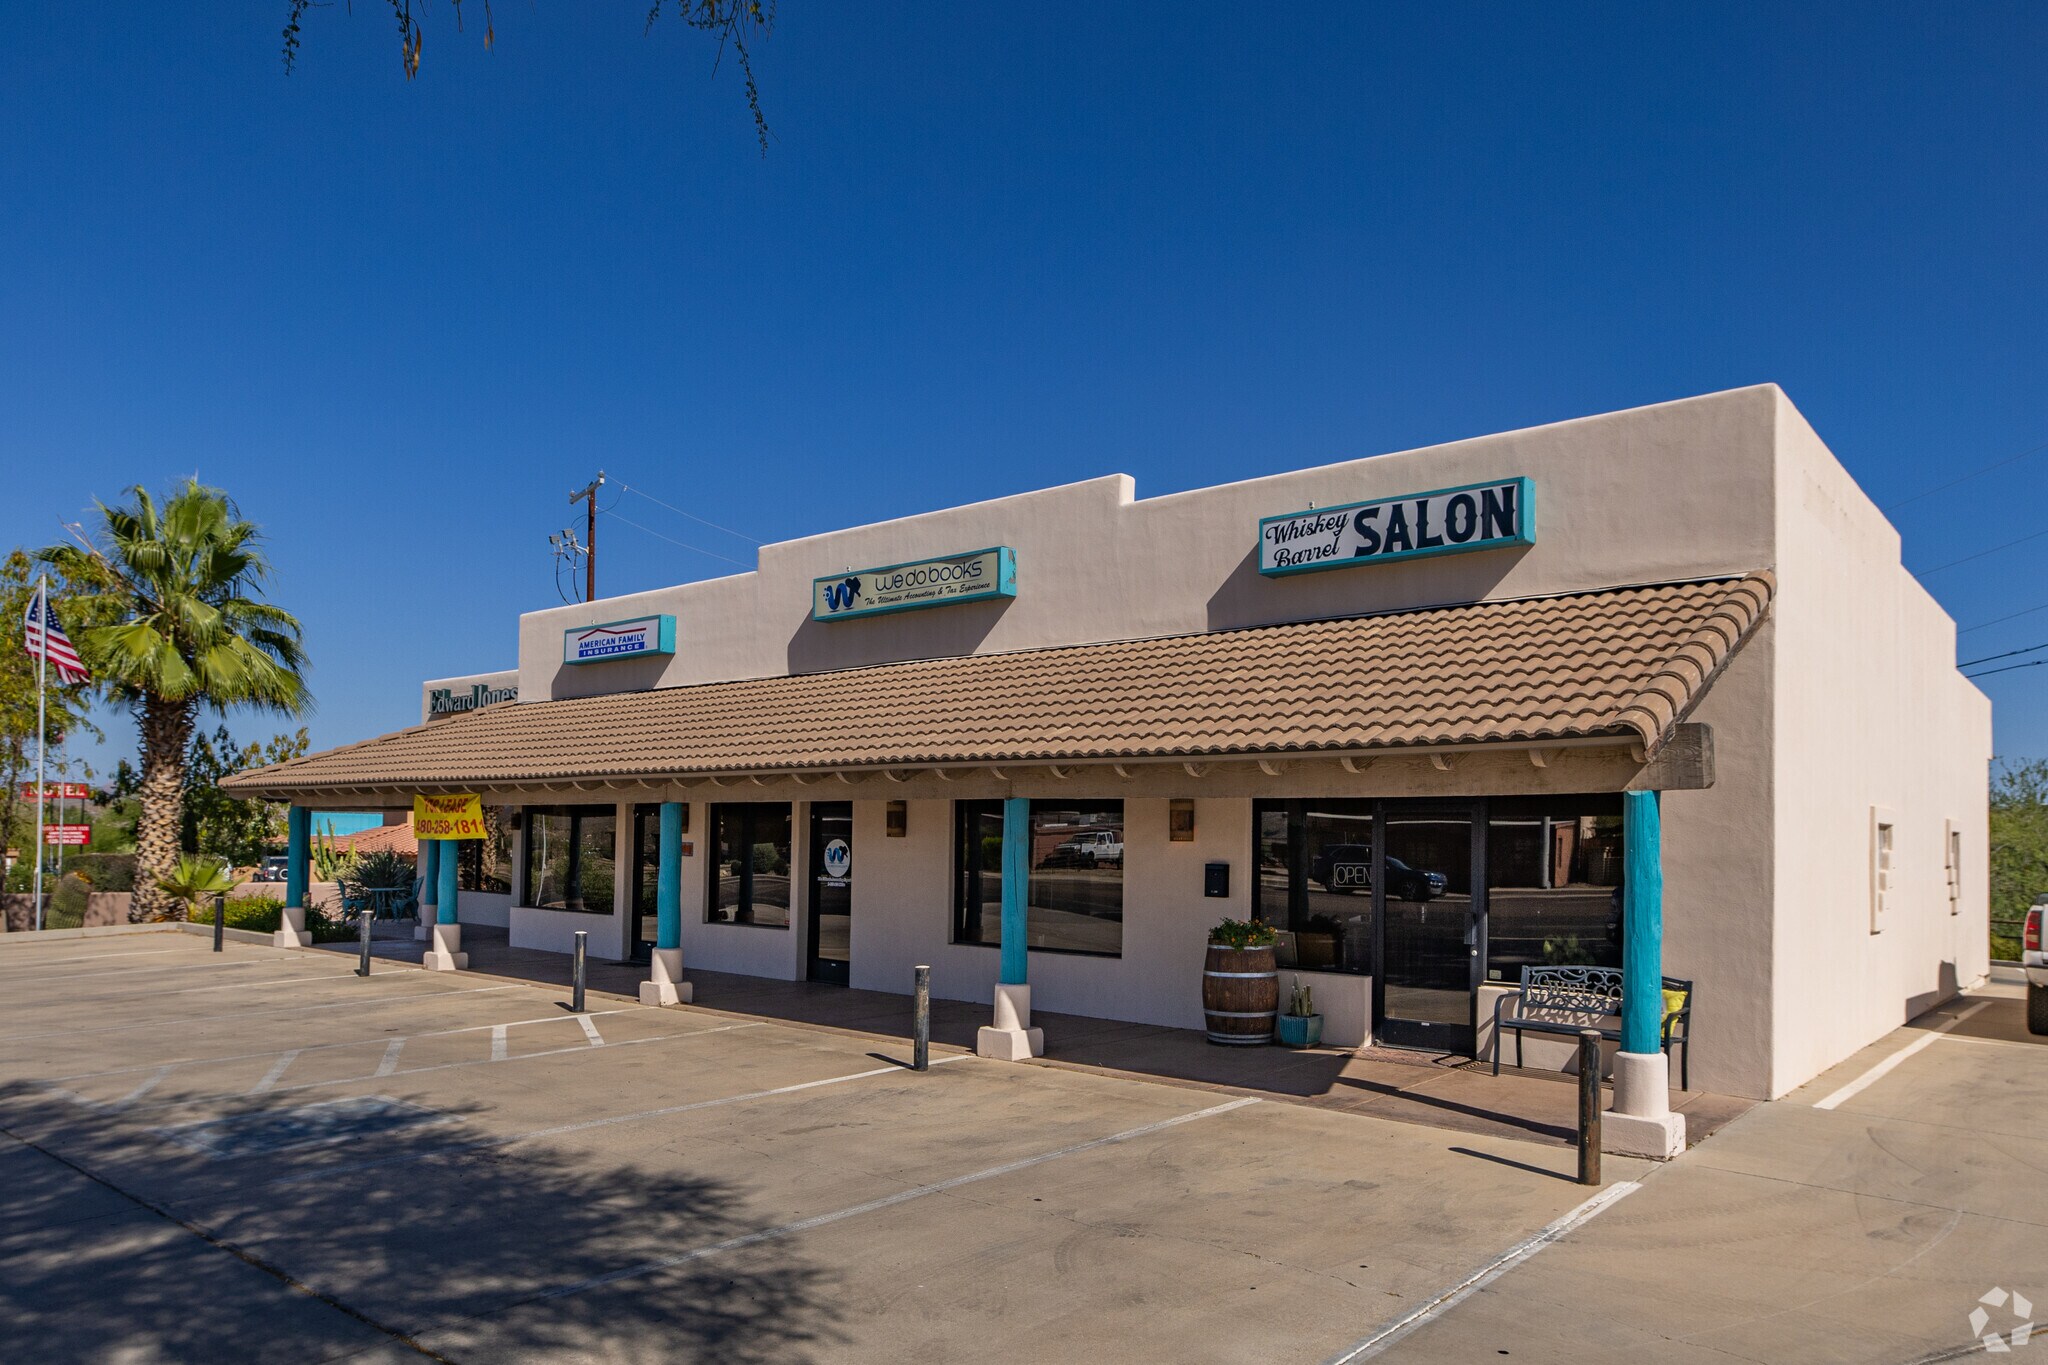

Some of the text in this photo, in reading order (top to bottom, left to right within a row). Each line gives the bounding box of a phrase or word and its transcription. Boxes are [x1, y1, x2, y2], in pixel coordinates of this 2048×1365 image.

[1265, 512, 1350, 546] Whiskey
[1353, 485, 1517, 558] SALON
[1273, 536, 1341, 568] Barrel
[864, 581, 991, 606] The Ultimate Accounting & Tax Experience
[579, 633, 646, 650] AMERICAN FAMILY
[583, 643, 640, 656] INSURANCE
[428, 684, 518, 714] Edward Jones
[1336, 866, 1372, 884] OPEN
